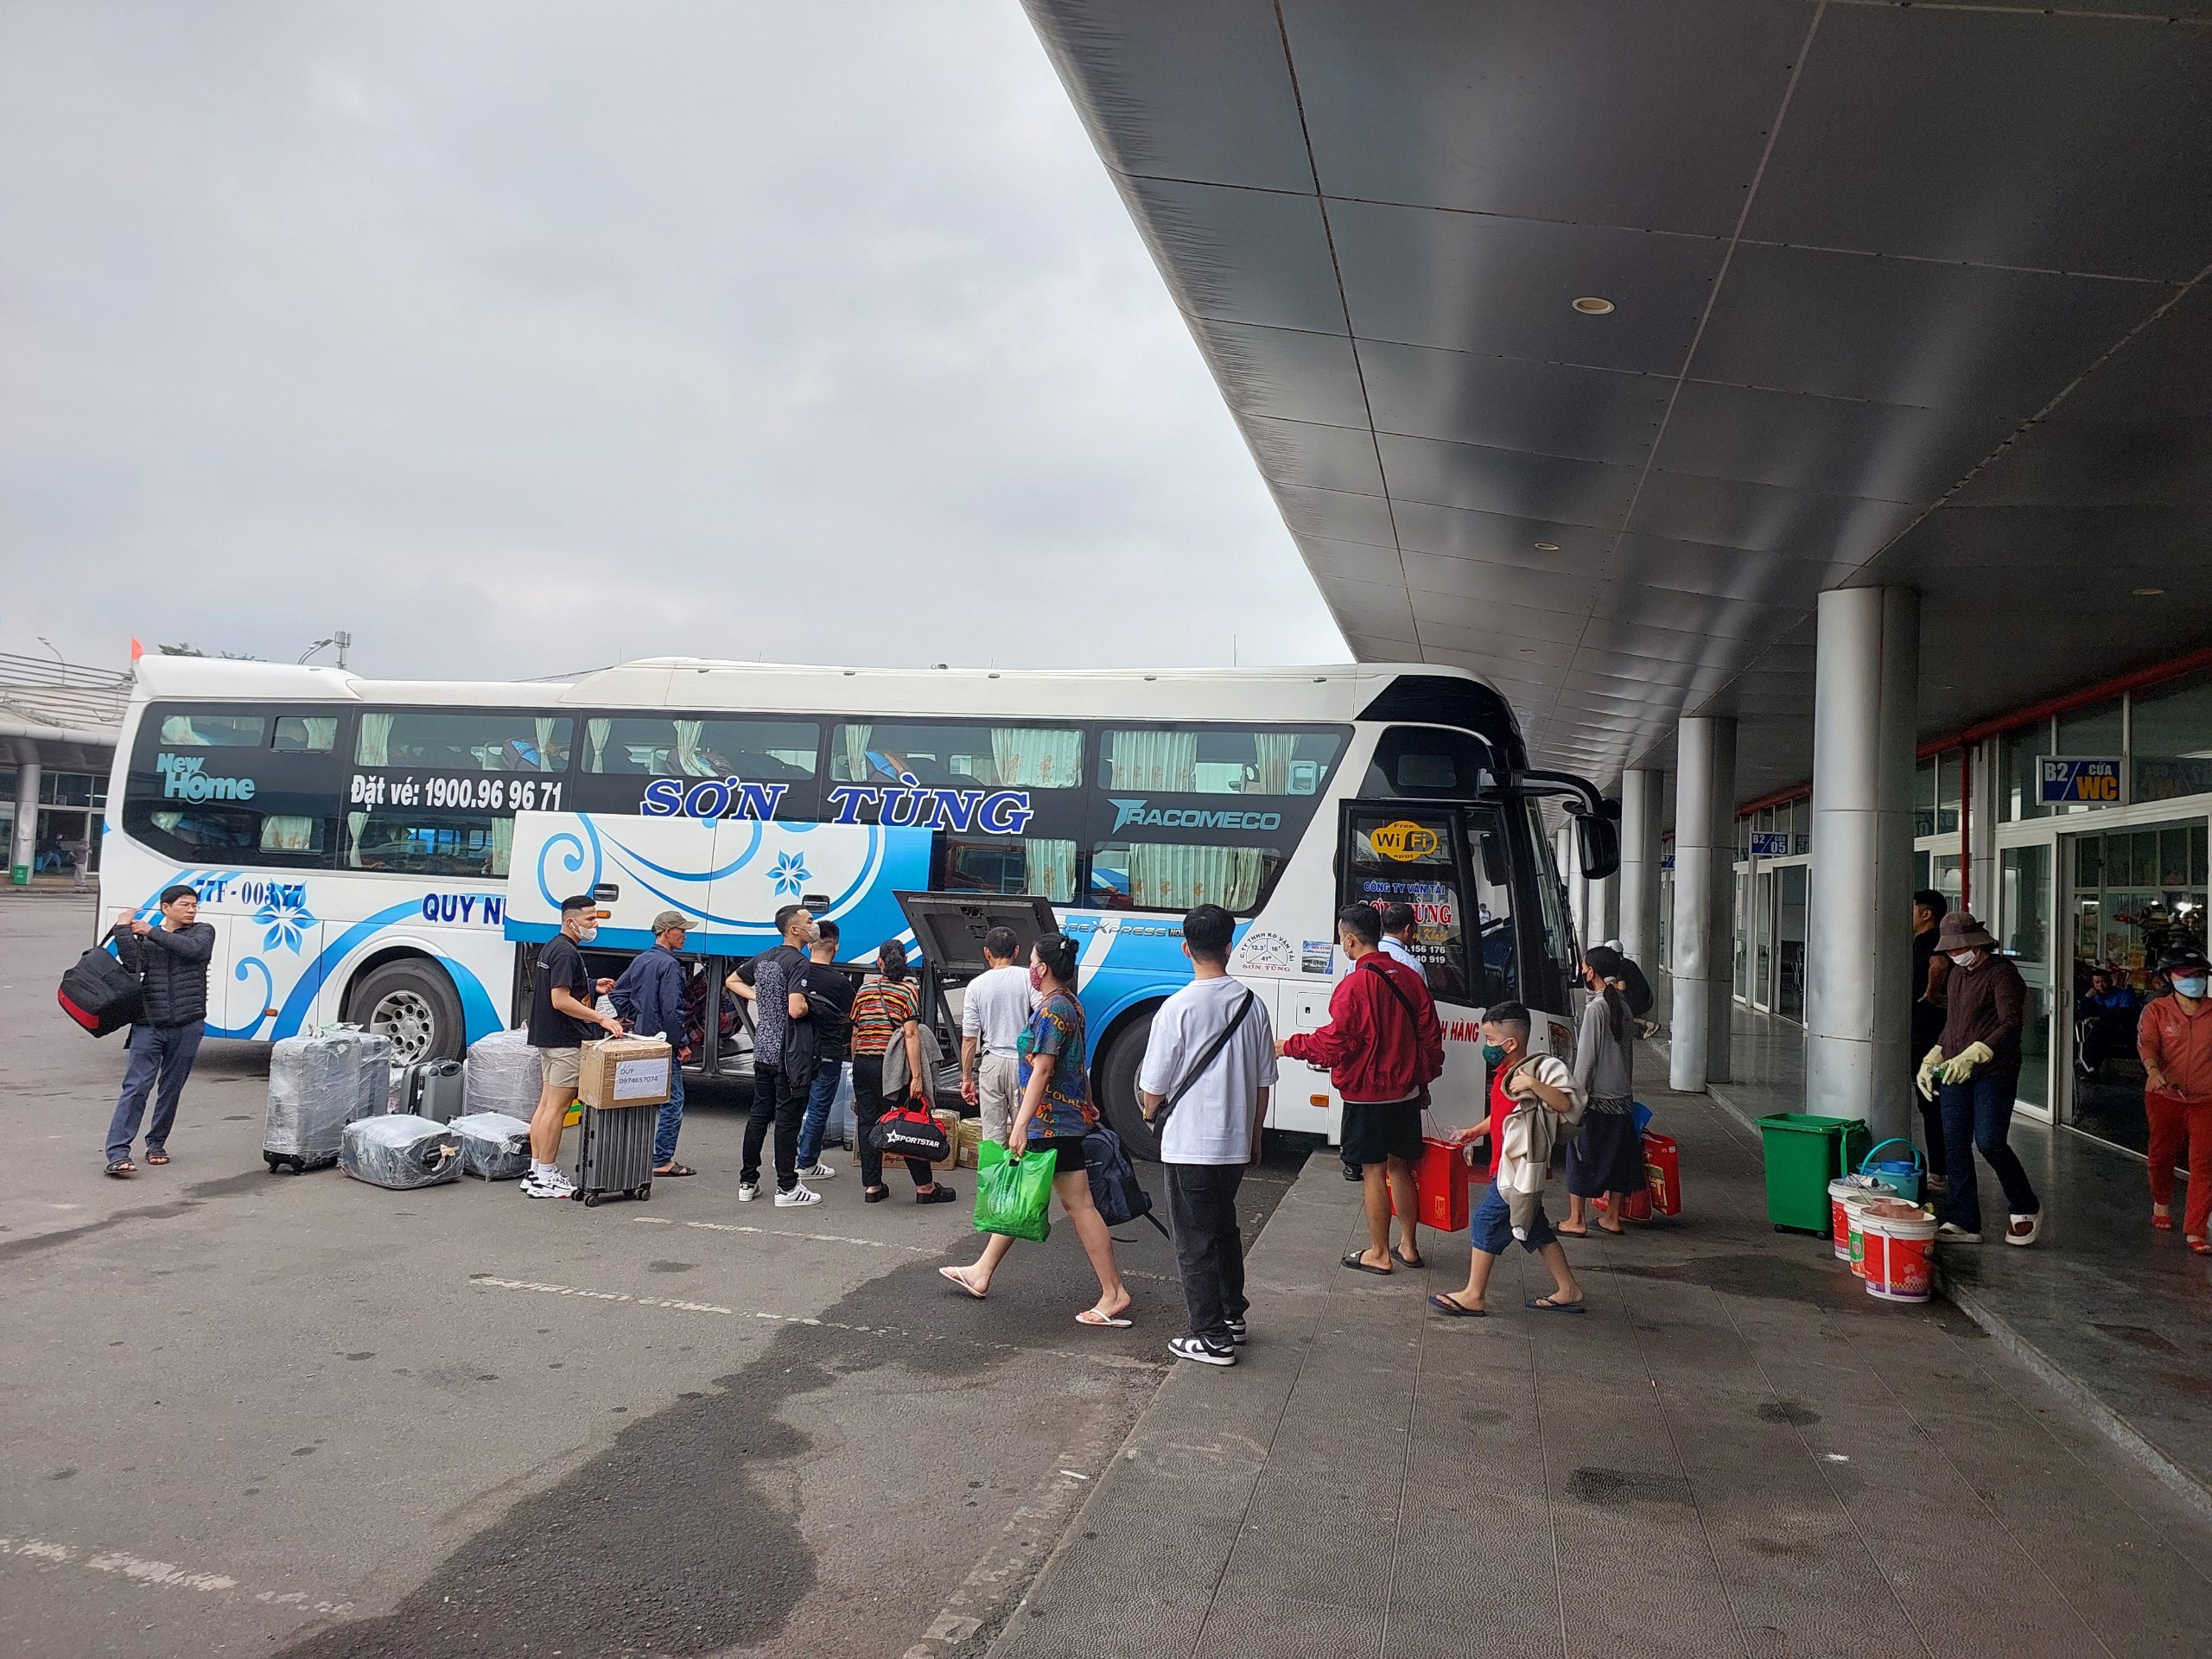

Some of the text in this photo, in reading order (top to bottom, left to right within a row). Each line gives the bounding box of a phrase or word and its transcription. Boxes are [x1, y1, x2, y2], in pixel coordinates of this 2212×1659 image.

[156, 753, 205, 772] New
[164, 771, 255, 804] Home
[351, 774, 563, 811] Đặt vé: 1900.96 96 71
[2076, 776, 2117, 800] WC
[640, 772, 1034, 835] SƠN TÙNG
[1107, 798, 1281, 836] TRACOMECO
[1770, 841, 1787, 854] 05
[1363, 880, 1390, 893] CÔNG
[1392, 883, 1406, 893] TY
[422, 893, 476, 924] QUY
[1410, 896, 1453, 925] ÙNG
[1247, 932, 1266, 944] TNHH
[1429, 945, 1446, 954] 176
[1450, 1017, 1480, 1043] HÀNG
[895, 1134, 940, 1148] SPORTSTAR
